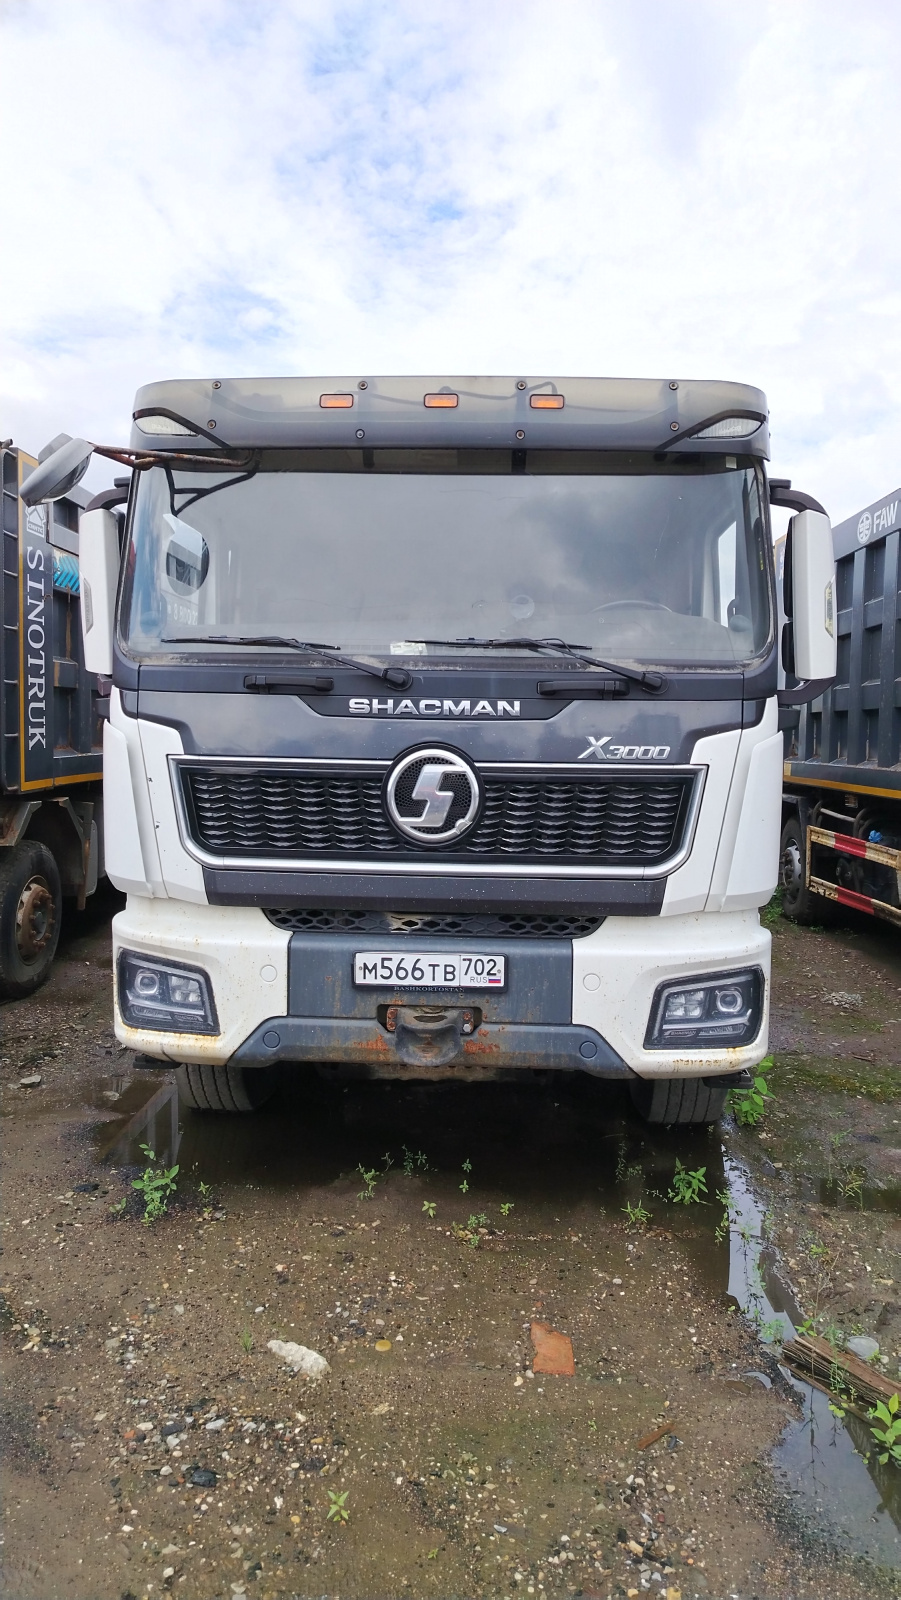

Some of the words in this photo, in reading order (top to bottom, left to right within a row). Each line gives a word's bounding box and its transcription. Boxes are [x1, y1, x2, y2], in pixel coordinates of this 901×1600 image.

[873, 500, 898, 534] FAW
[27, 546, 46, 751] SINOTRUK
[348, 698, 521, 717] SHACMAN
[578, 736, 671, 759] X3000
[462, 958, 497, 976] 702
